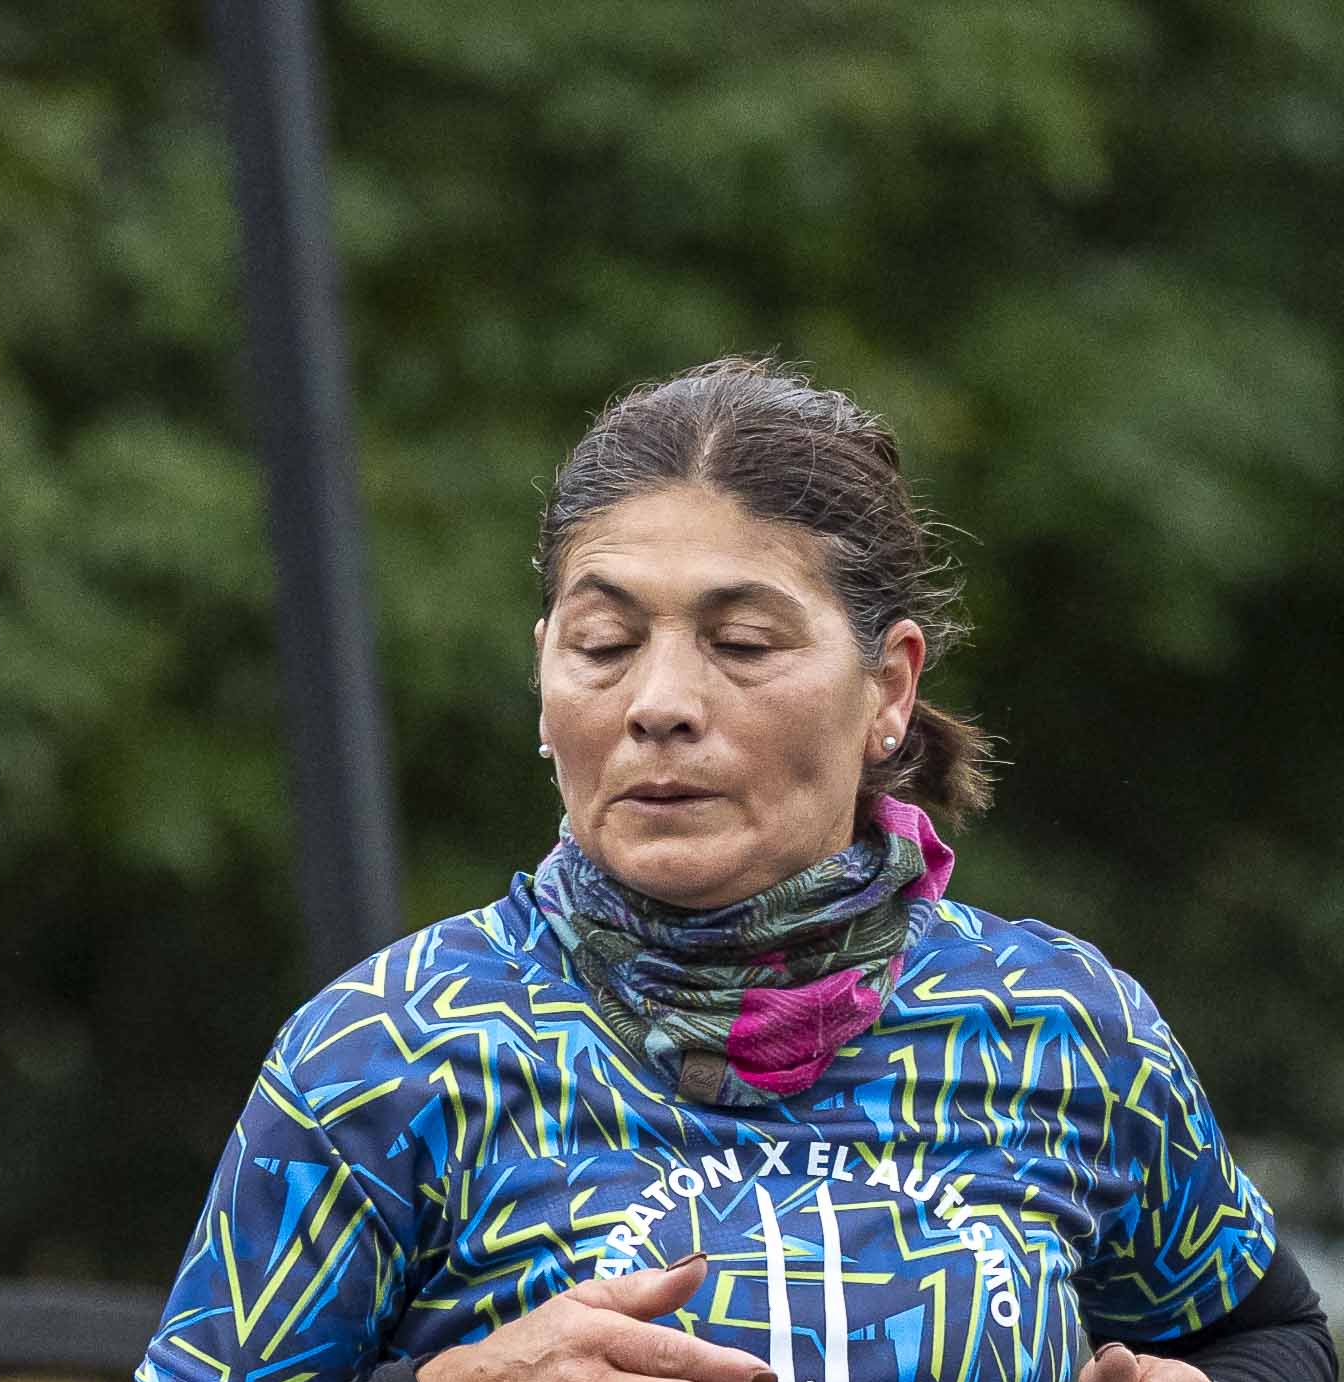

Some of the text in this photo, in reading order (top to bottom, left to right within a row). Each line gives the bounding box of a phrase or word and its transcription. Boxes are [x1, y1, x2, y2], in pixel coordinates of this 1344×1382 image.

[594, 1141, 1020, 1328] ARATÓN X EL AUTISMO
